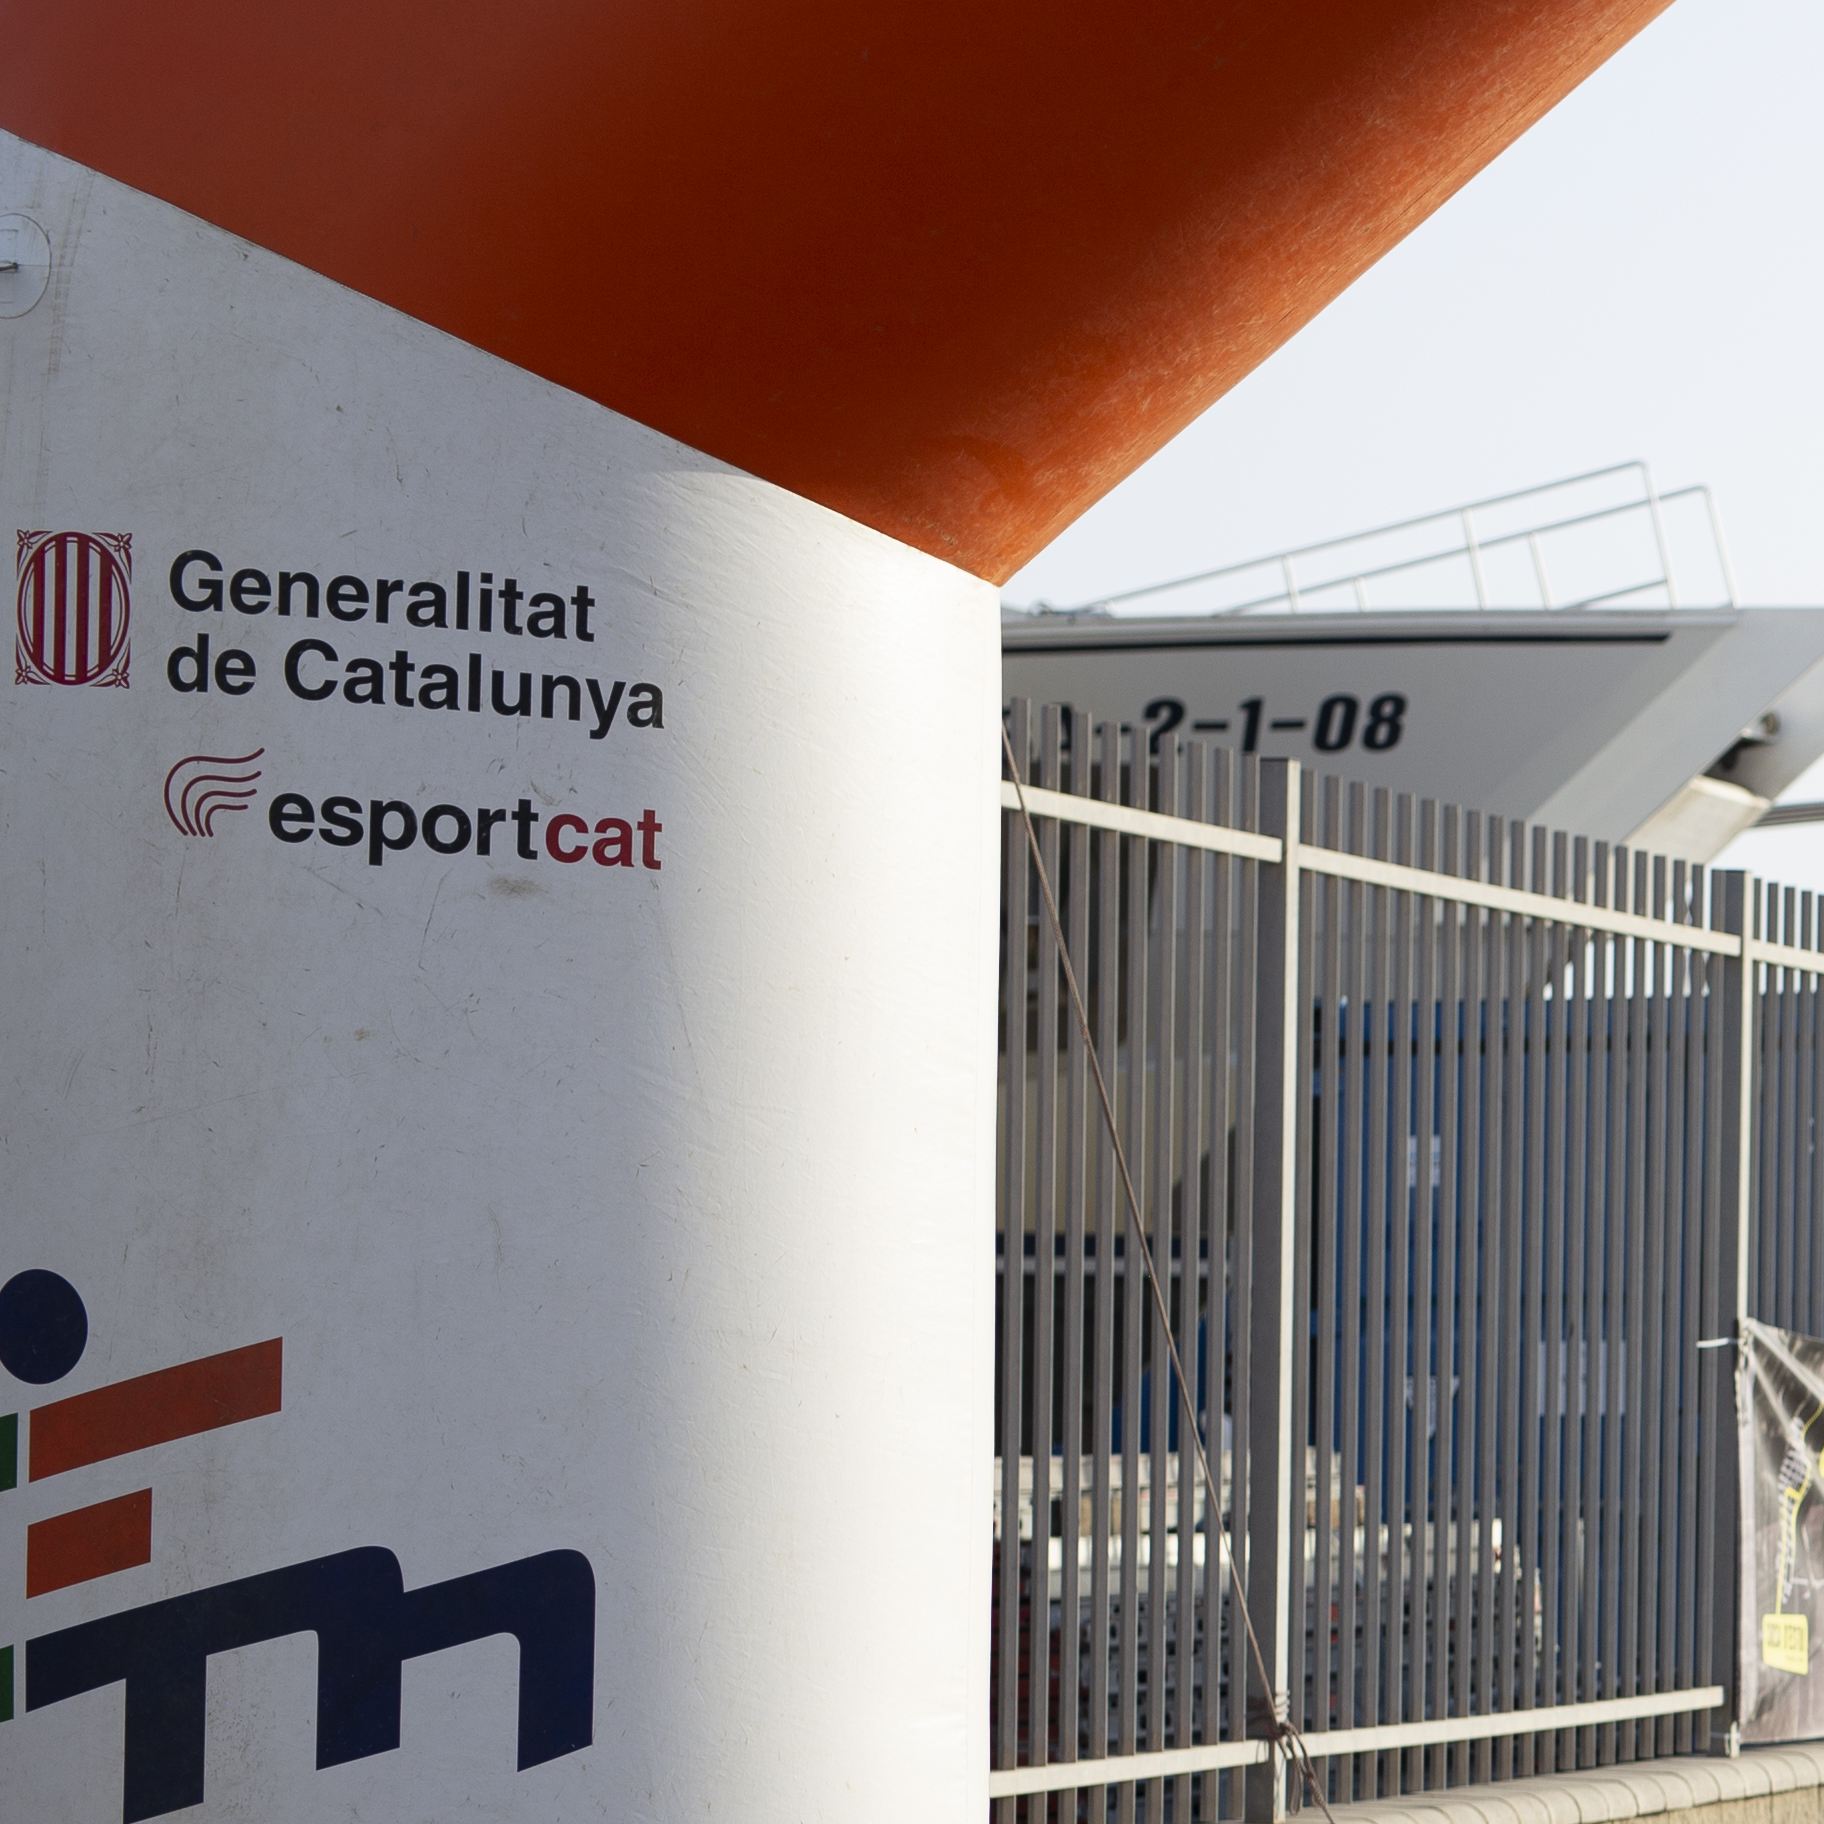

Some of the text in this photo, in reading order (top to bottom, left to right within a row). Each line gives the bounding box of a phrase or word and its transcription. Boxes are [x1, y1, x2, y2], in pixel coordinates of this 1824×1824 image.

[168, 548, 596, 643] Generalitat
[166, 633, 665, 740] de Catalunya
[267, 790, 662, 871] esportcat
